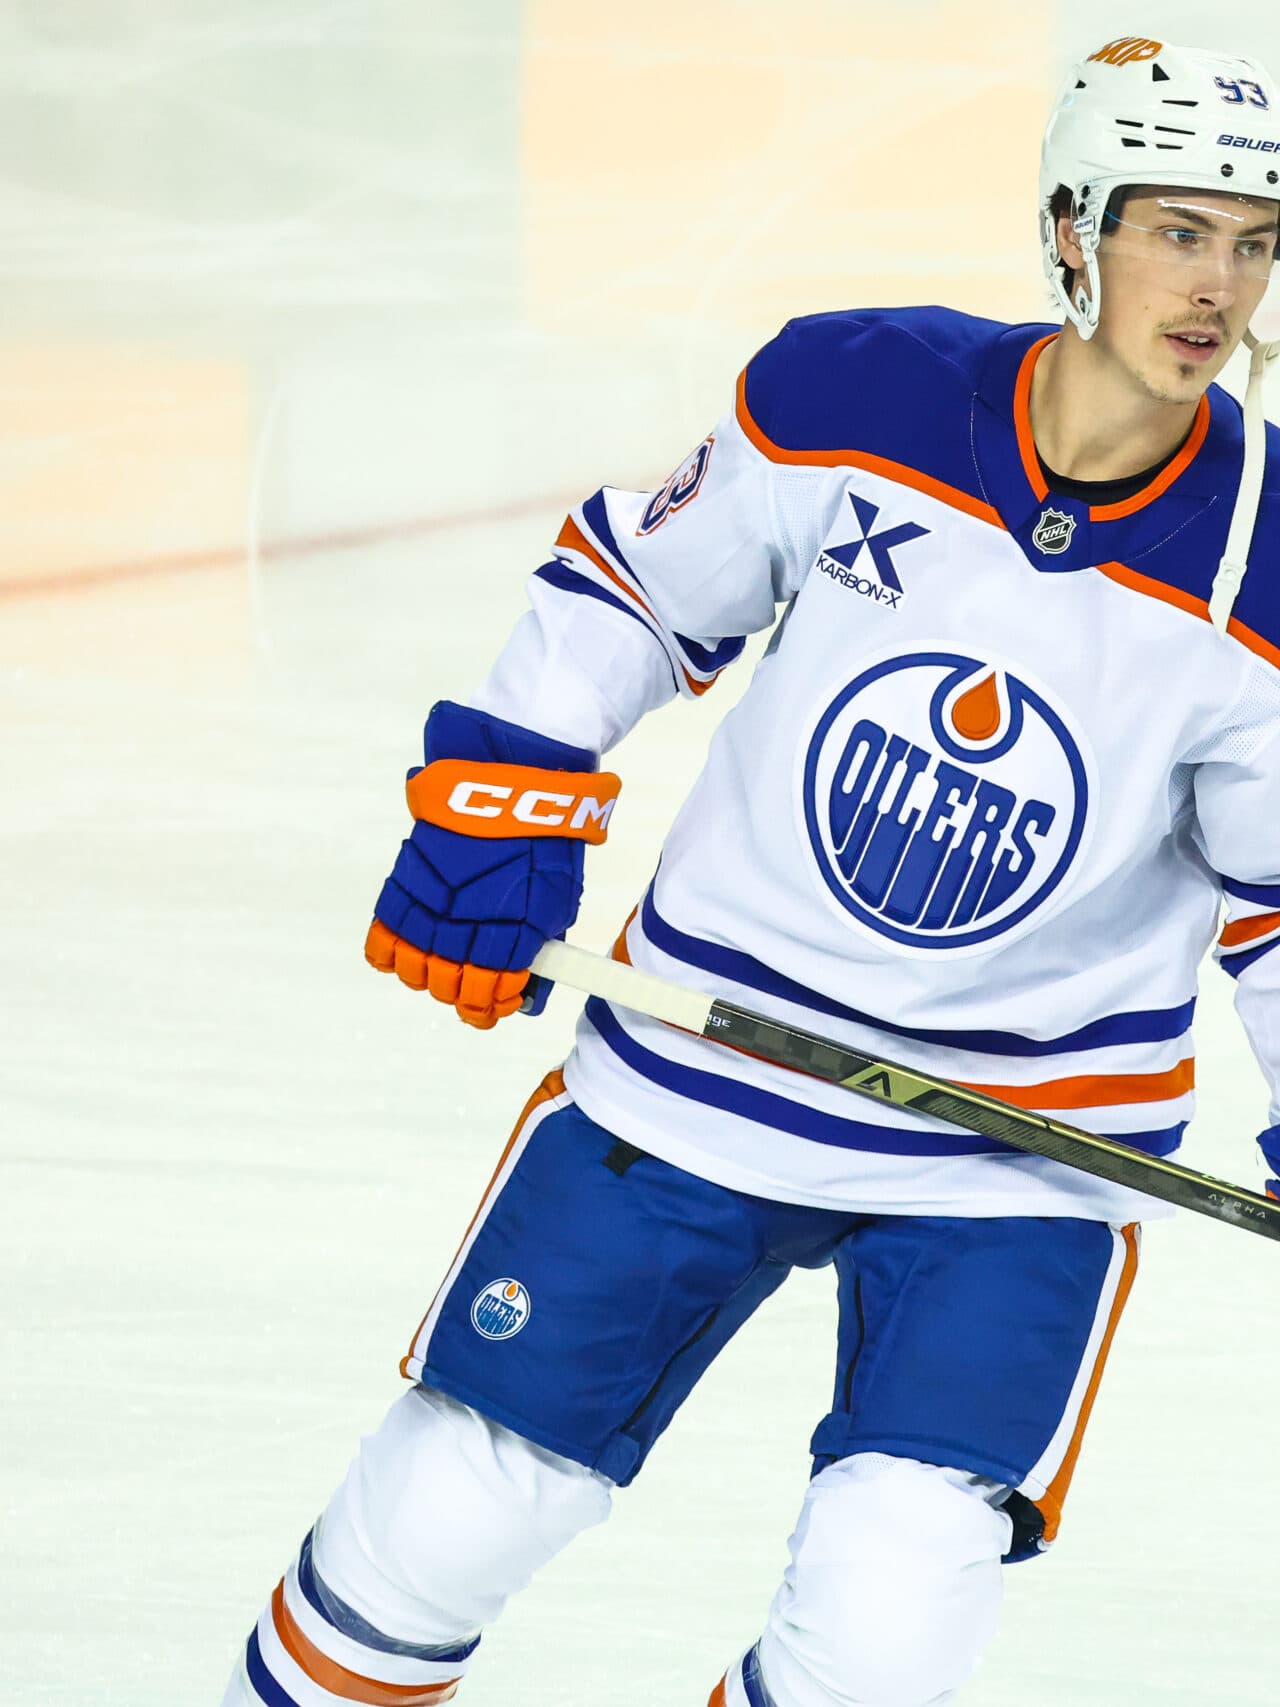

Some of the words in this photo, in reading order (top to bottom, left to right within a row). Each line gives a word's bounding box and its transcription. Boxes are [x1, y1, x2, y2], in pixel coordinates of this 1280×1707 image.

[1039, 524, 1067, 541] NHL
[816, 554, 902, 609] KARBON-X
[447, 781, 617, 830] CCM
[829, 718, 1057, 930] OILERS
